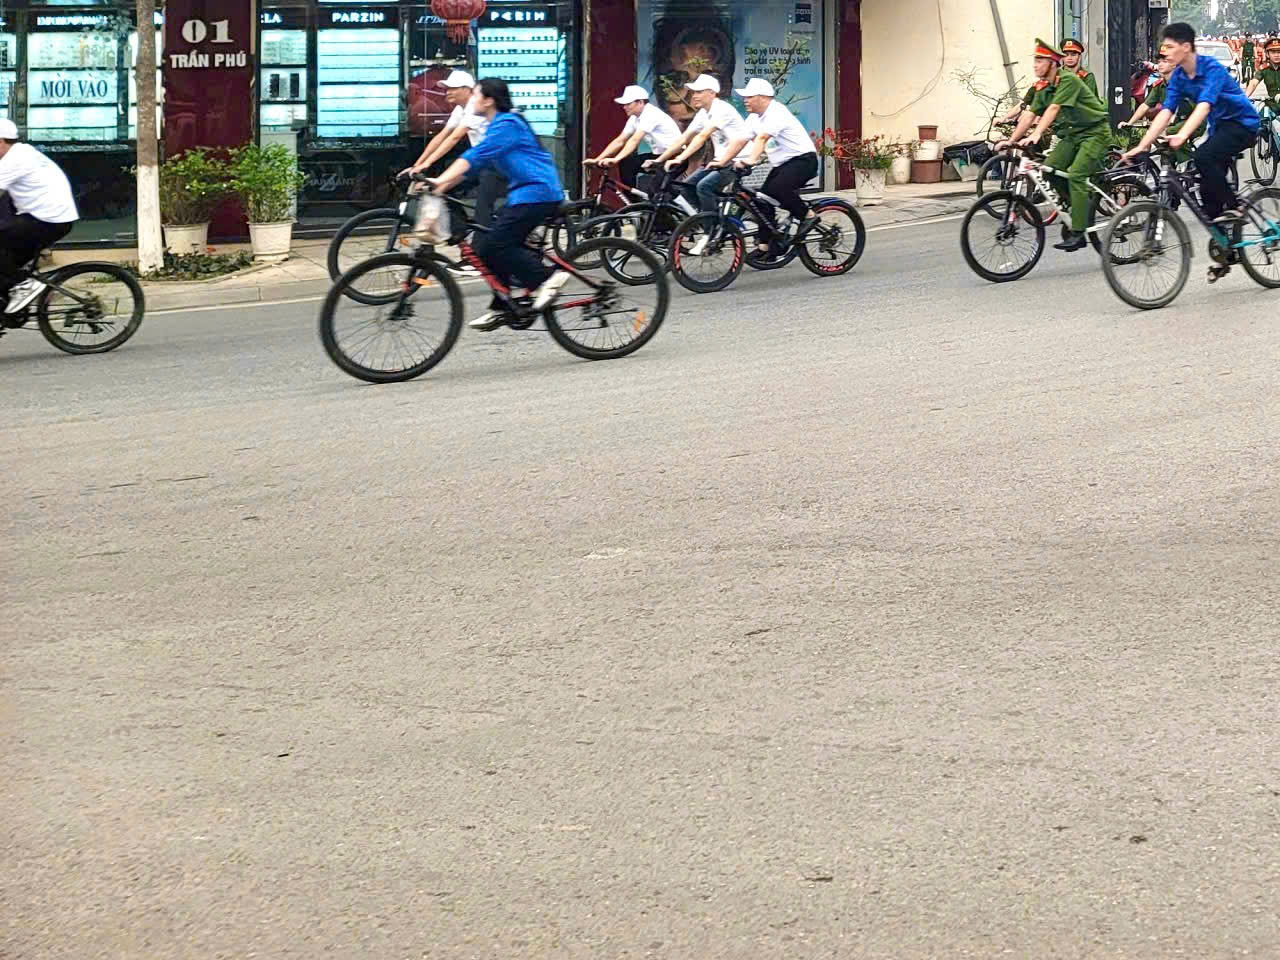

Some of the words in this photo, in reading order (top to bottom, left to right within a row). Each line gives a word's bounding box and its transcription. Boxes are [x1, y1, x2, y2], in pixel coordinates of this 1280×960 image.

[332, 12, 385, 23] PARZIN
[182, 19, 234, 44] 01
[214, 50, 247, 68] PHÚ
[41, 72, 72, 98] MỜI
[78, 72, 108, 98] VÀO
